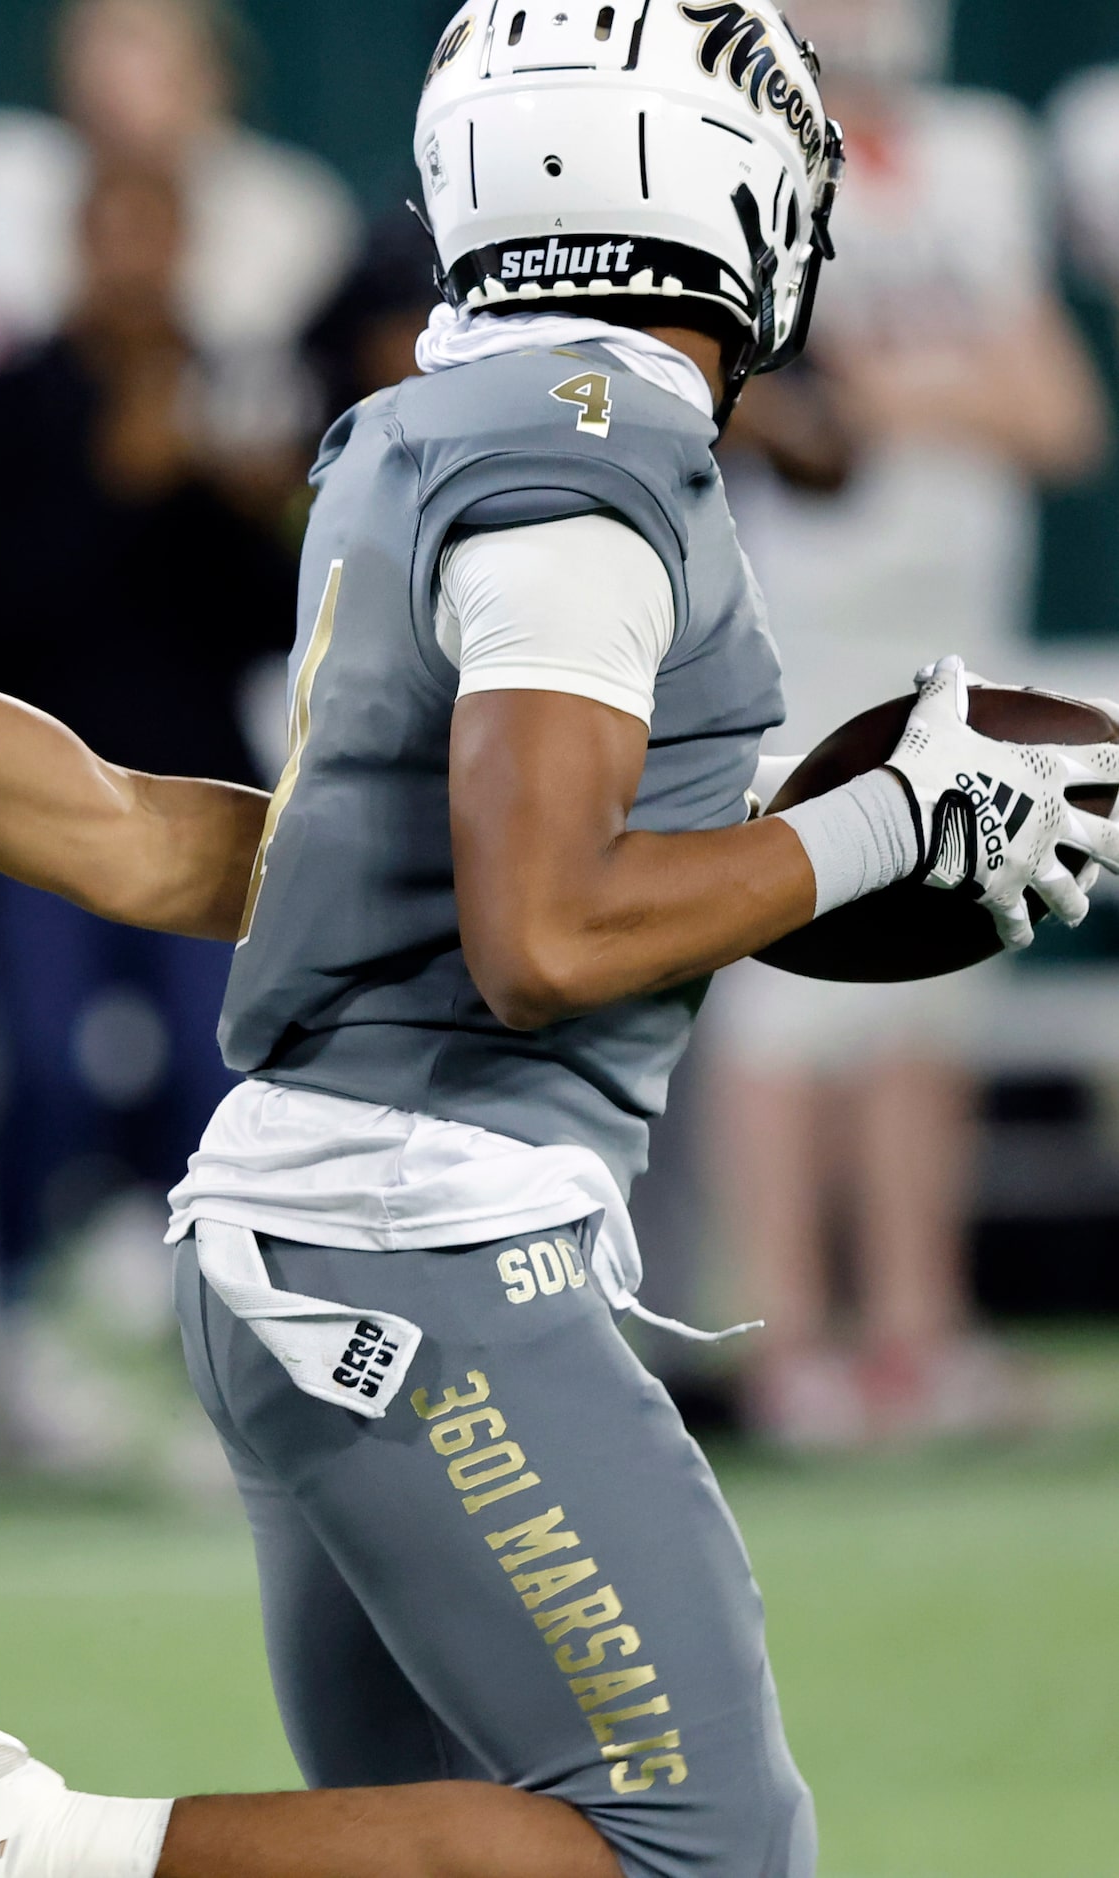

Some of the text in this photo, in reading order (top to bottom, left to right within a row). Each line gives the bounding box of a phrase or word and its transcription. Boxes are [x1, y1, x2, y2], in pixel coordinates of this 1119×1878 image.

[501, 238, 635, 279] schutt
[548, 370, 613, 439] 4
[955, 773, 1004, 871] adidas
[496, 1238, 586, 1305] SOC
[410, 1369, 689, 1795] 3601 MARSALIS
